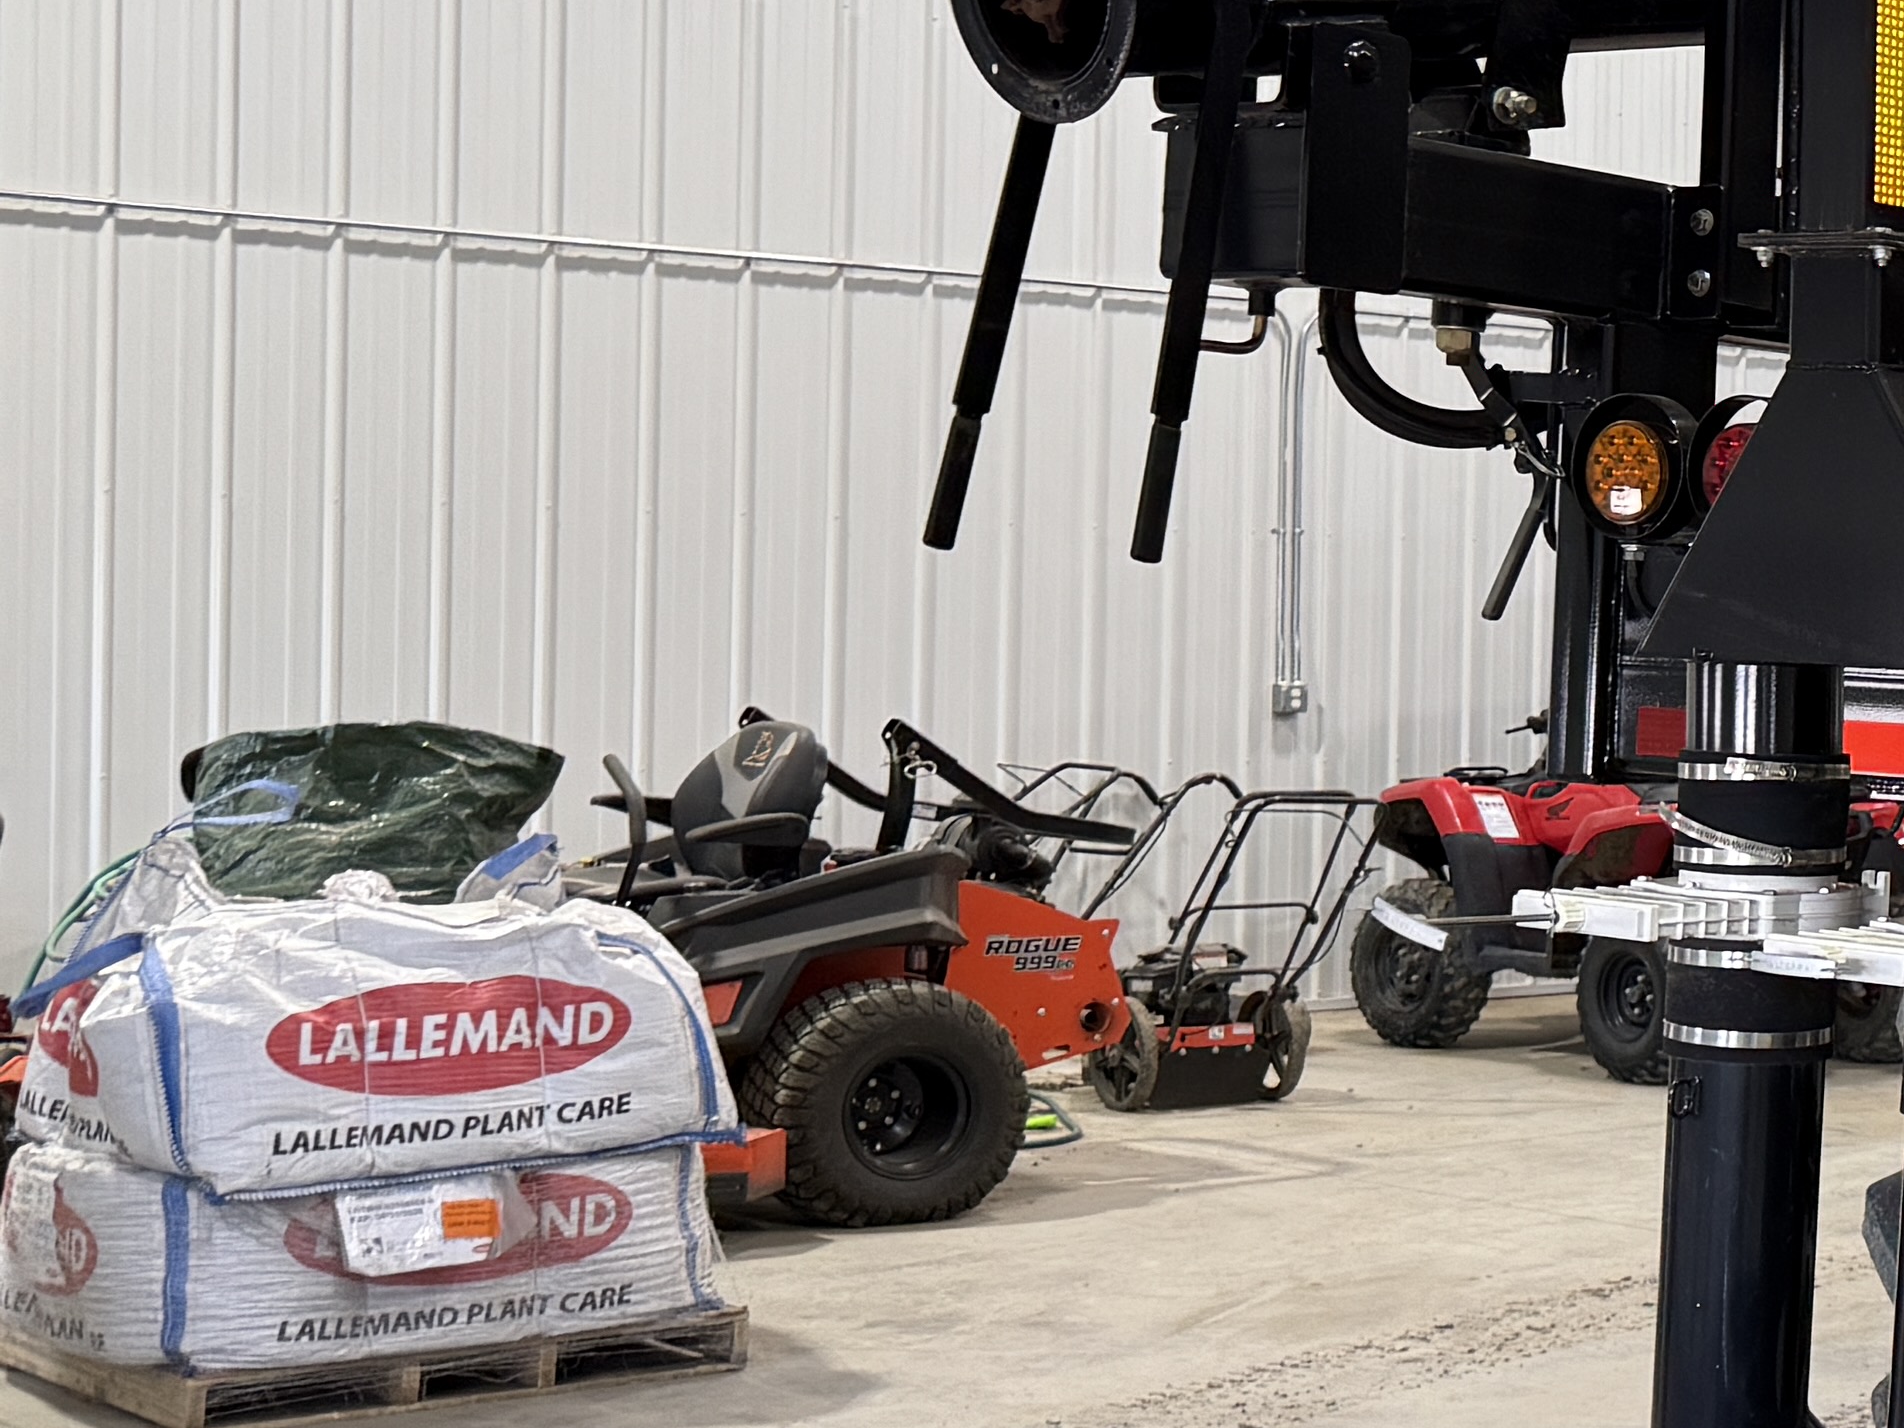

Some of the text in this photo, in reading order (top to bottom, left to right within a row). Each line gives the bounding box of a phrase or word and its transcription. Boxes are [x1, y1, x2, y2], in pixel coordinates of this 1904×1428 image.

[985, 936, 1082, 955] ROGUE
[298, 1000, 615, 1067] LALLEMAND
[272, 1092, 633, 1157] LALLEMAND PLANT CARE
[275, 1283, 635, 1343] LALLEMAND PLANT CARE
